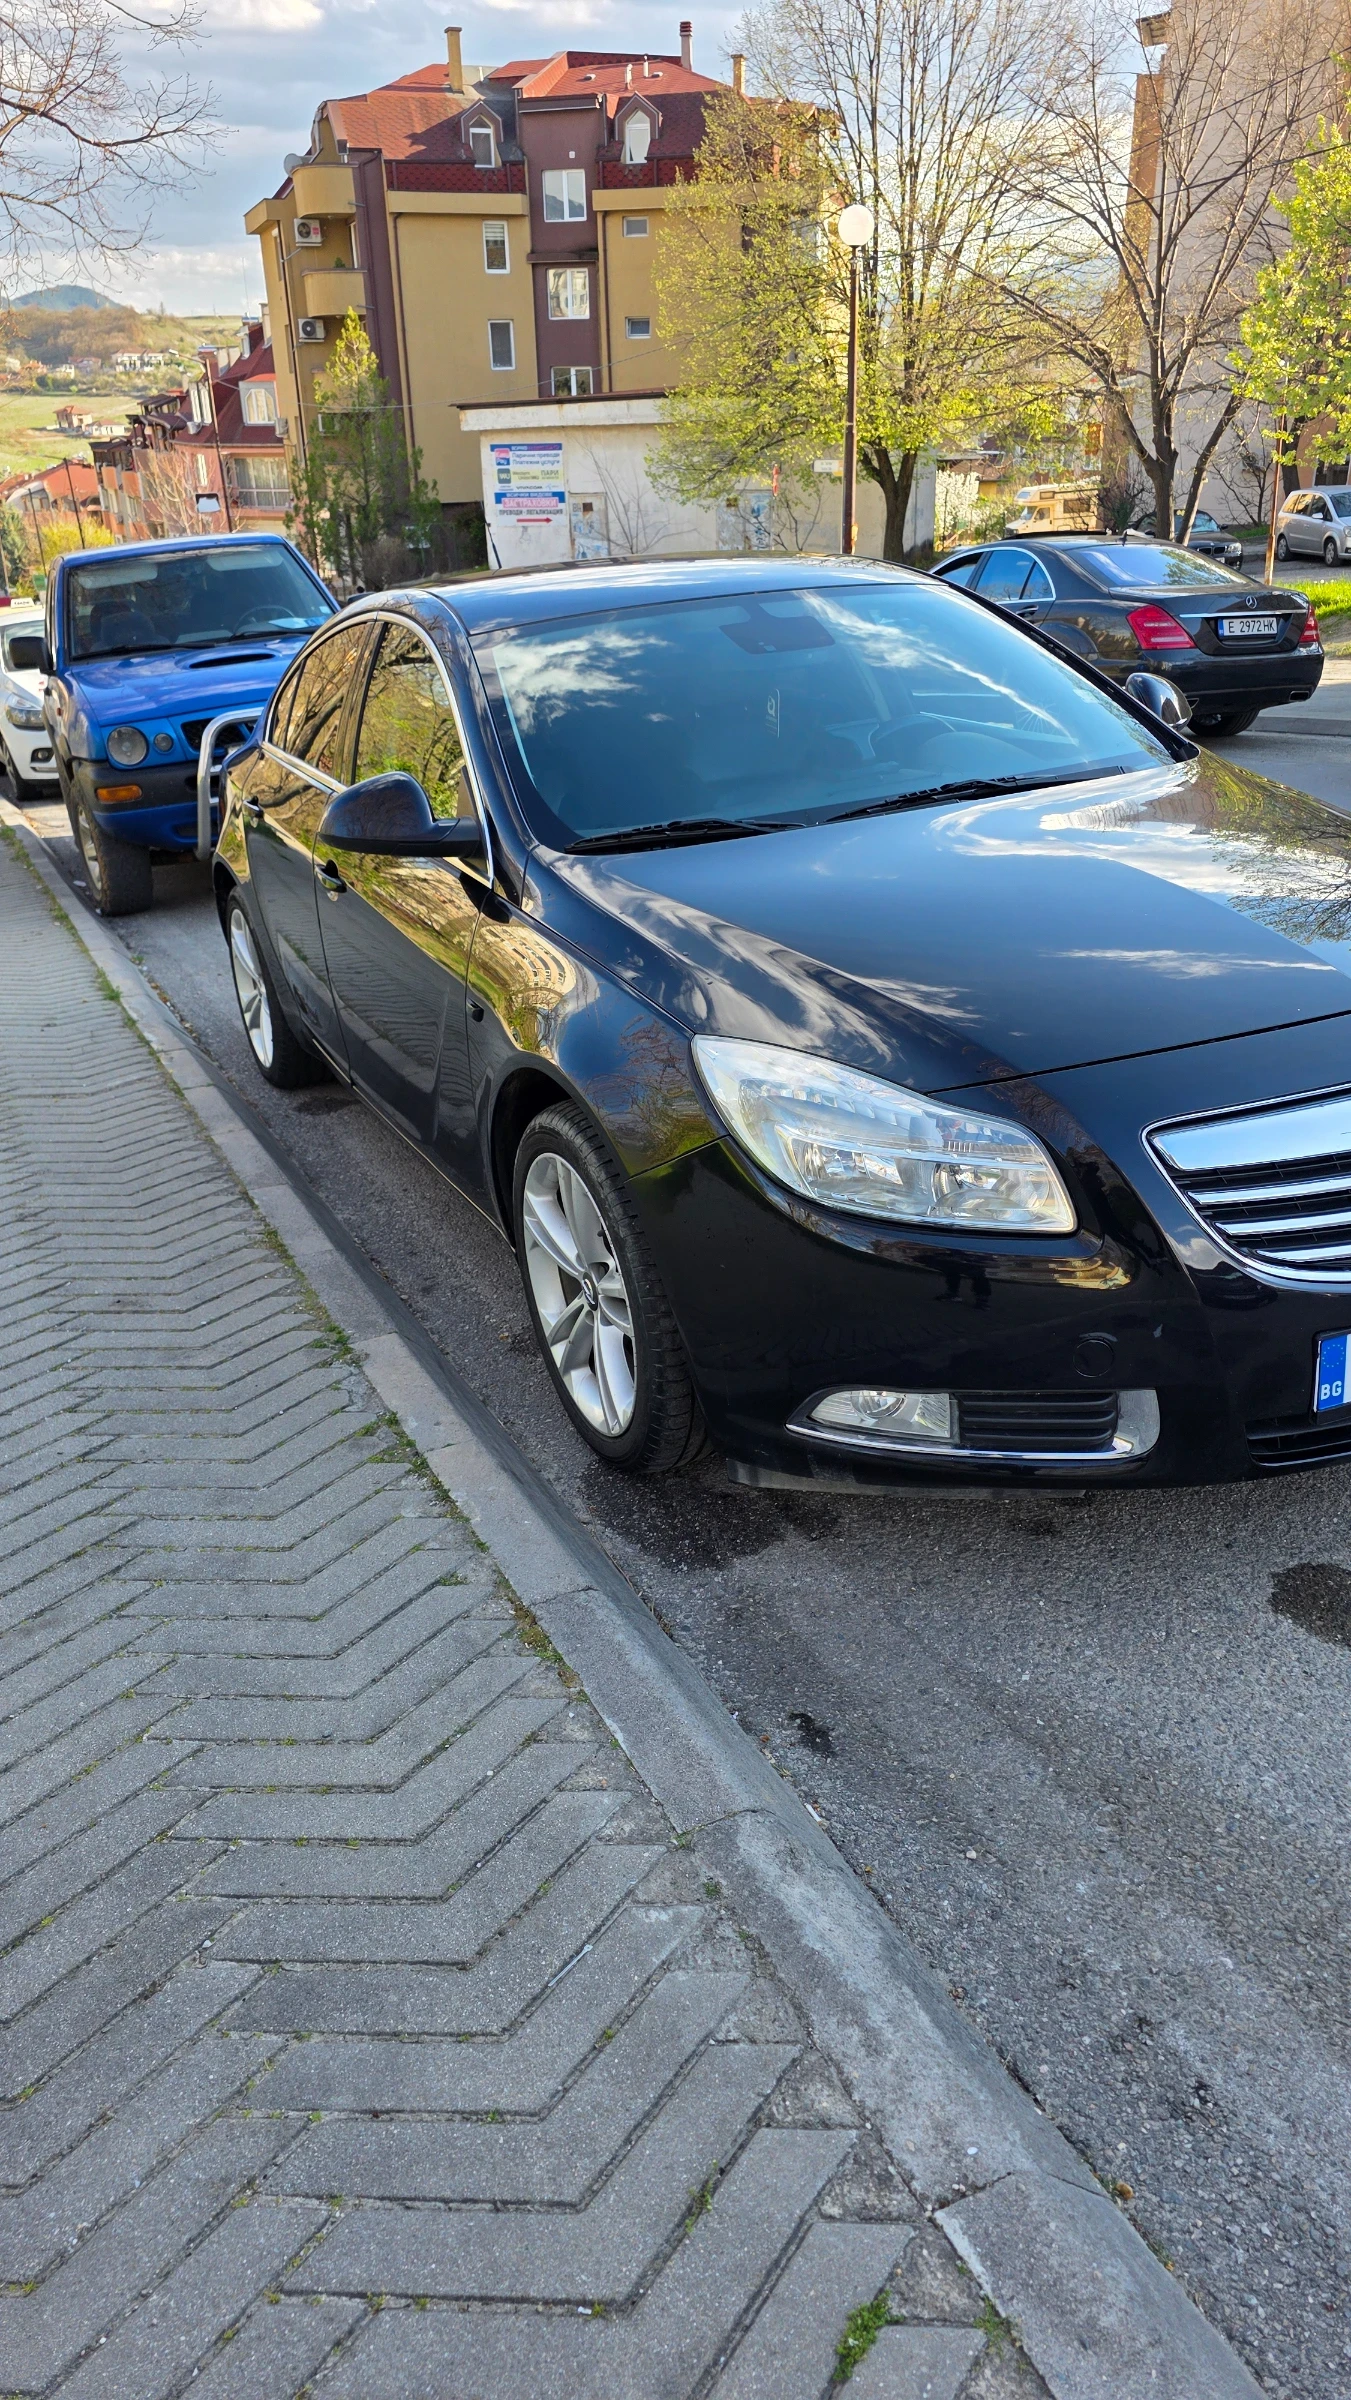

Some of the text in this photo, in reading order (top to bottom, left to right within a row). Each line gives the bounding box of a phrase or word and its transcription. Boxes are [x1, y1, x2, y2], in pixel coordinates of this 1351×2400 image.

[503, 498, 558, 508] ЗАСТРАХОВКИ
[526, 508, 563, 516] ЛЕГАЛИЗАЦИЯ
[1228, 619, 1276, 634] E 2972 HK
[1320, 1380, 1342, 1400] BG
